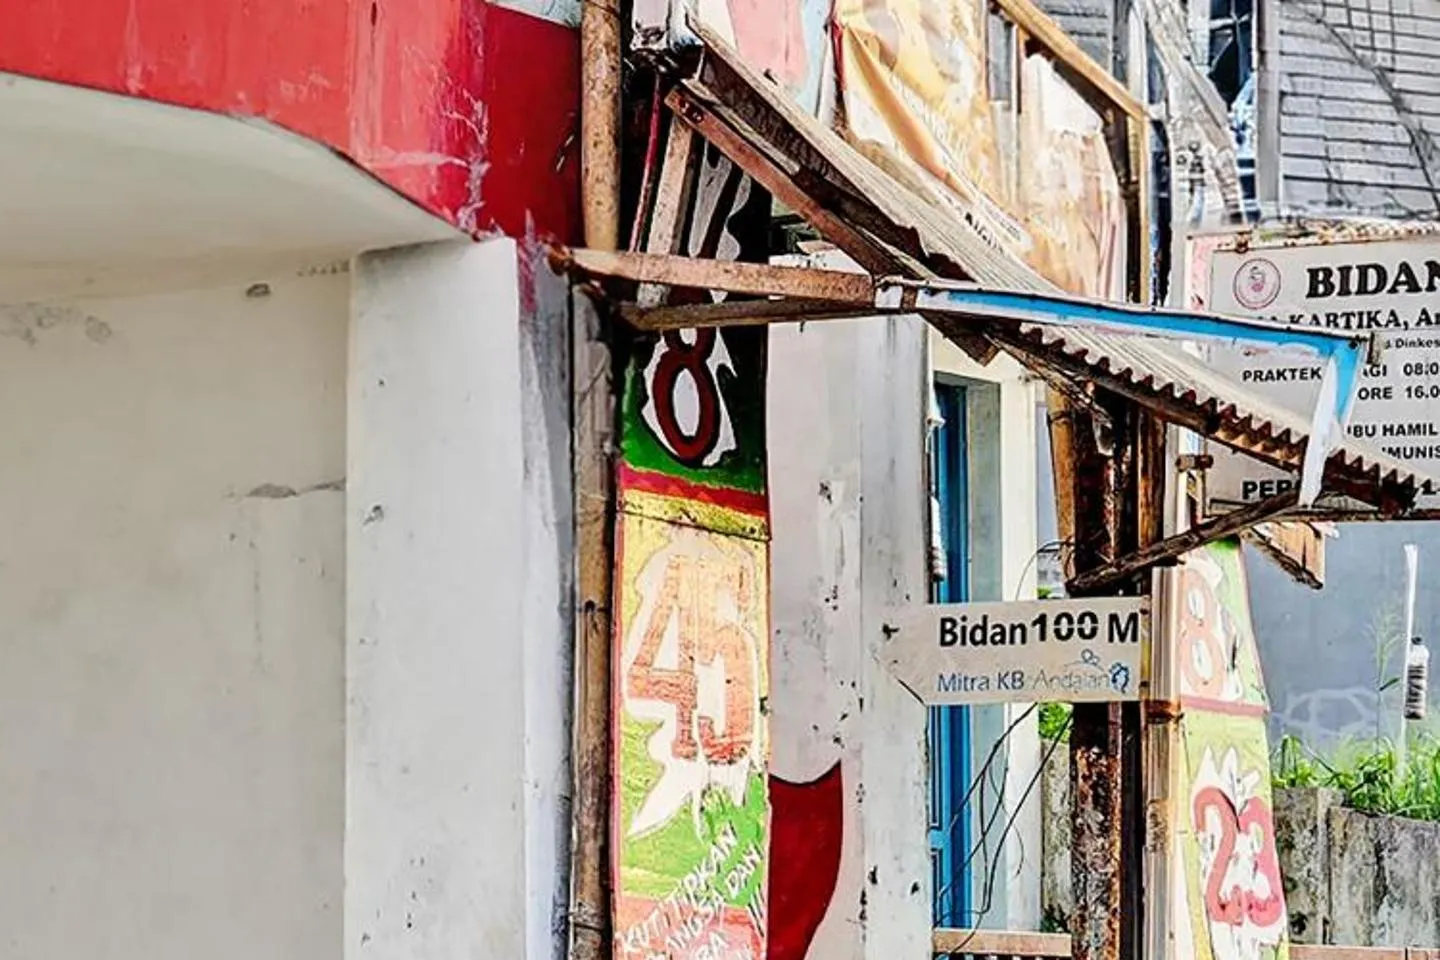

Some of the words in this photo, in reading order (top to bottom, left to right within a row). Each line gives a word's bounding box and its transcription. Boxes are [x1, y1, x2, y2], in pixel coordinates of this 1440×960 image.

[1243, 367, 1322, 382] PRAKTEK
[1363, 363, 1387, 377] GI
[1359, 386, 1393, 400] ORE
[1406, 385, 1440, 399] 16.0
[1382, 423, 1438, 436] HAMIL
[939, 615, 1027, 647] Bidan
[1031, 612, 1099, 643] 100
[1107, 612, 1139, 643] M
[1180, 566, 1226, 698] 8
[627, 554, 753, 765] 45
[937, 671, 991, 692] Mitra
[997, 671, 1025, 690] KB
